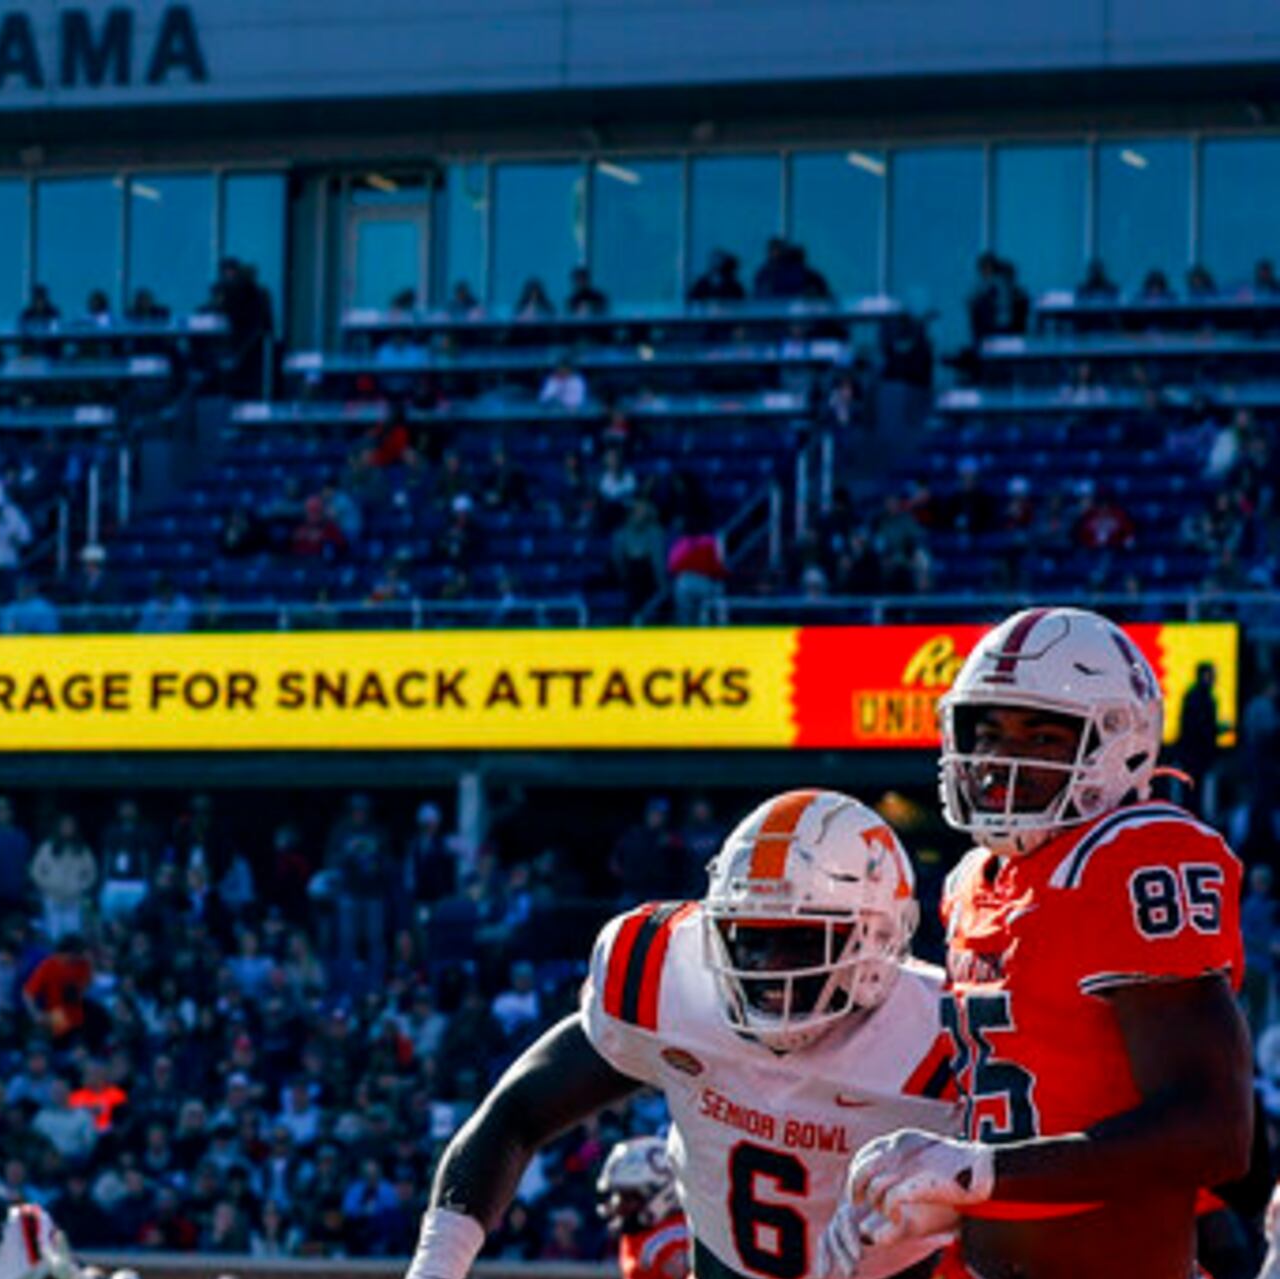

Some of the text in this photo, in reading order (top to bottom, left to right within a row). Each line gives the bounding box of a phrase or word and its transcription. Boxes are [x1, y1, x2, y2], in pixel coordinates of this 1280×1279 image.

[148, 671, 259, 711] FOR
[276, 670, 467, 710] SNACK
[485, 668, 752, 709] ATTACKS
[1129, 863, 1224, 941] 85
[698, 1087, 851, 1156] SENIOR BOWL
